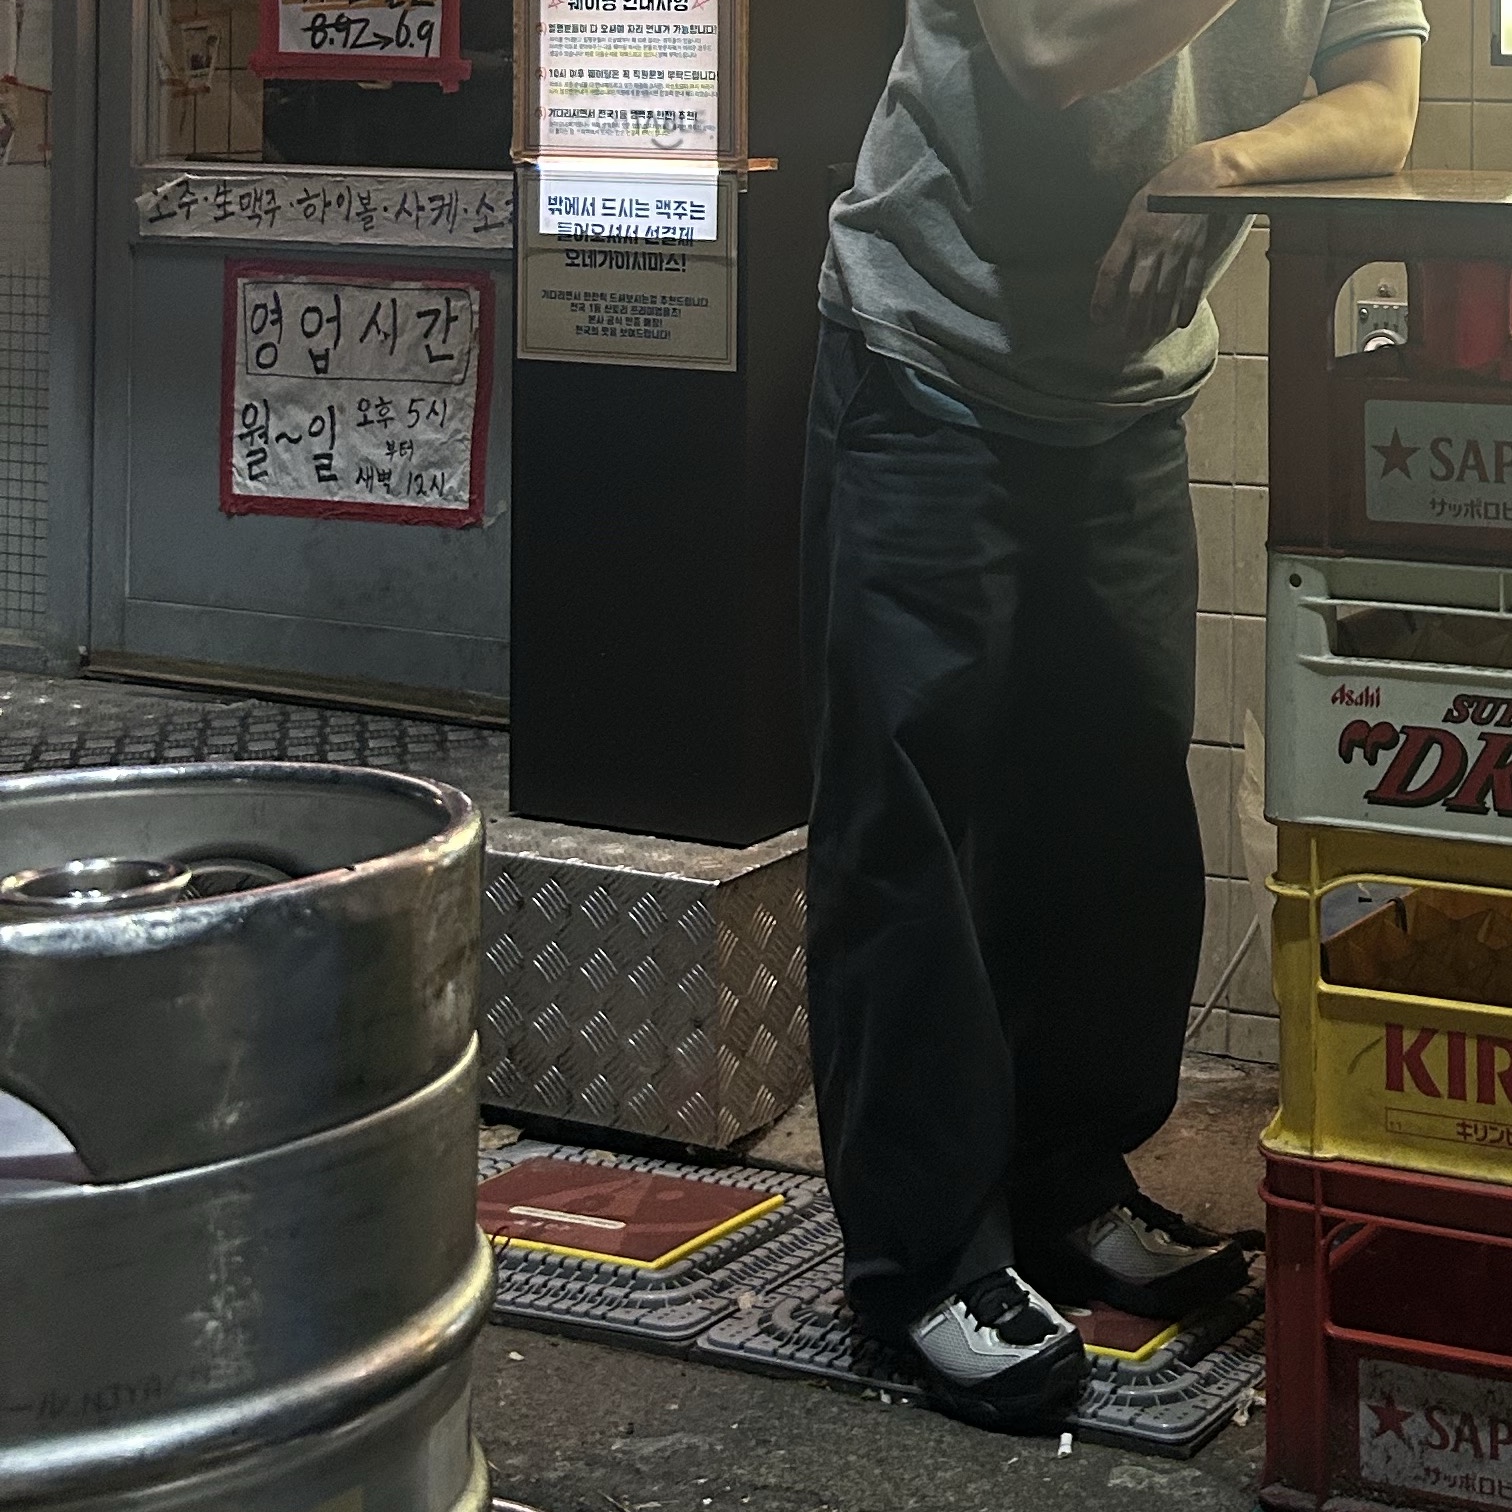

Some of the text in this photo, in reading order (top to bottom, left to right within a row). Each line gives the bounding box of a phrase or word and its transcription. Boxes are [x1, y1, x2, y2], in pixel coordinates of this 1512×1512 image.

[395, 9, 435, 58] 6.9
[627, 24, 643, 35] 자리
[548, 68, 566, 80] 10시
[569, 69, 584, 80] 이후
[547, 195, 706, 221] 밖에서 드시는 맥주는
[557, 221, 694, 247] 들어오셔서 선결제
[564, 249, 687, 273] 오네가이시마스!
[570, 302, 586, 313] 전국
[251, 290, 459, 375] 영업시간
[356, 396, 394, 428] 오후
[408, 398, 448, 429] 5시
[385, 440, 414, 460] 부터
[355, 467, 445, 497] 새벽 12시
[1331, 684, 1382, 709] Asahi
